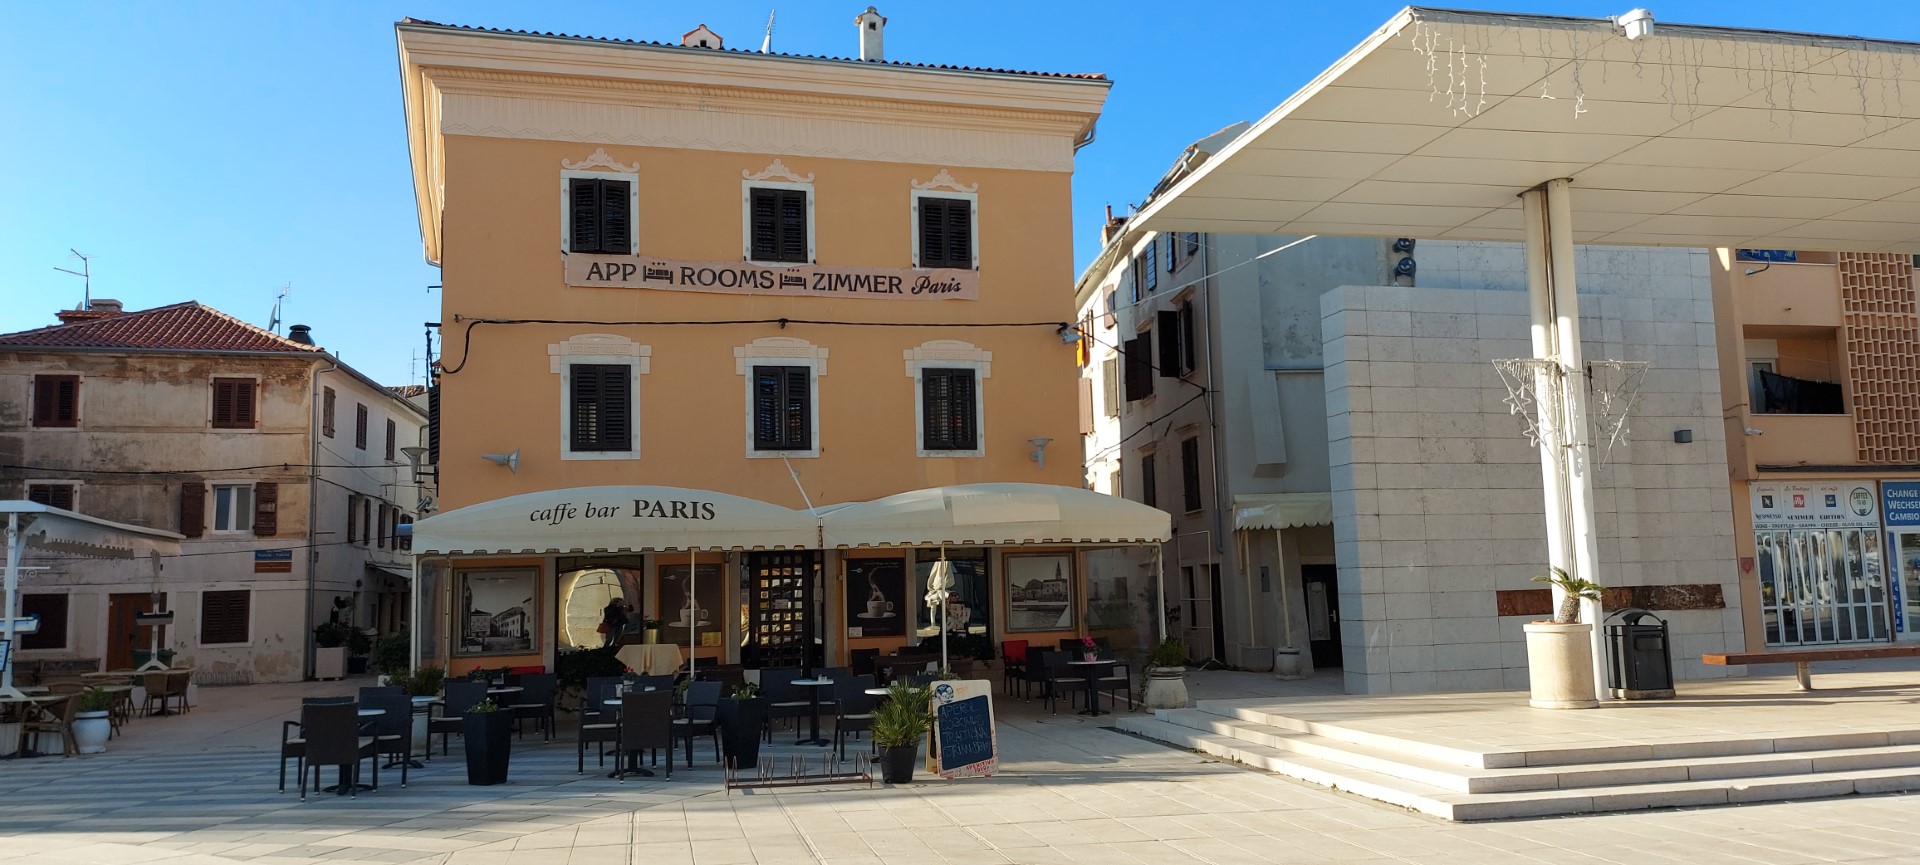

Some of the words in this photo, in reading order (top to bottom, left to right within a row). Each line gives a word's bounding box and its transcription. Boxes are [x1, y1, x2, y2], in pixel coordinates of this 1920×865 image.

[586, 262, 637, 281] APP
[679, 266, 775, 289] ROOMS
[812, 272, 903, 294] ZIMMER
[911, 275, 961, 295] Paris
[1887, 489, 1919, 498] CHANGE
[530, 502, 577, 526] caffe
[585, 502, 620, 519] bar
[632, 499, 716, 521] PARIS
[1889, 511, 1920, 521] CAMBIO
